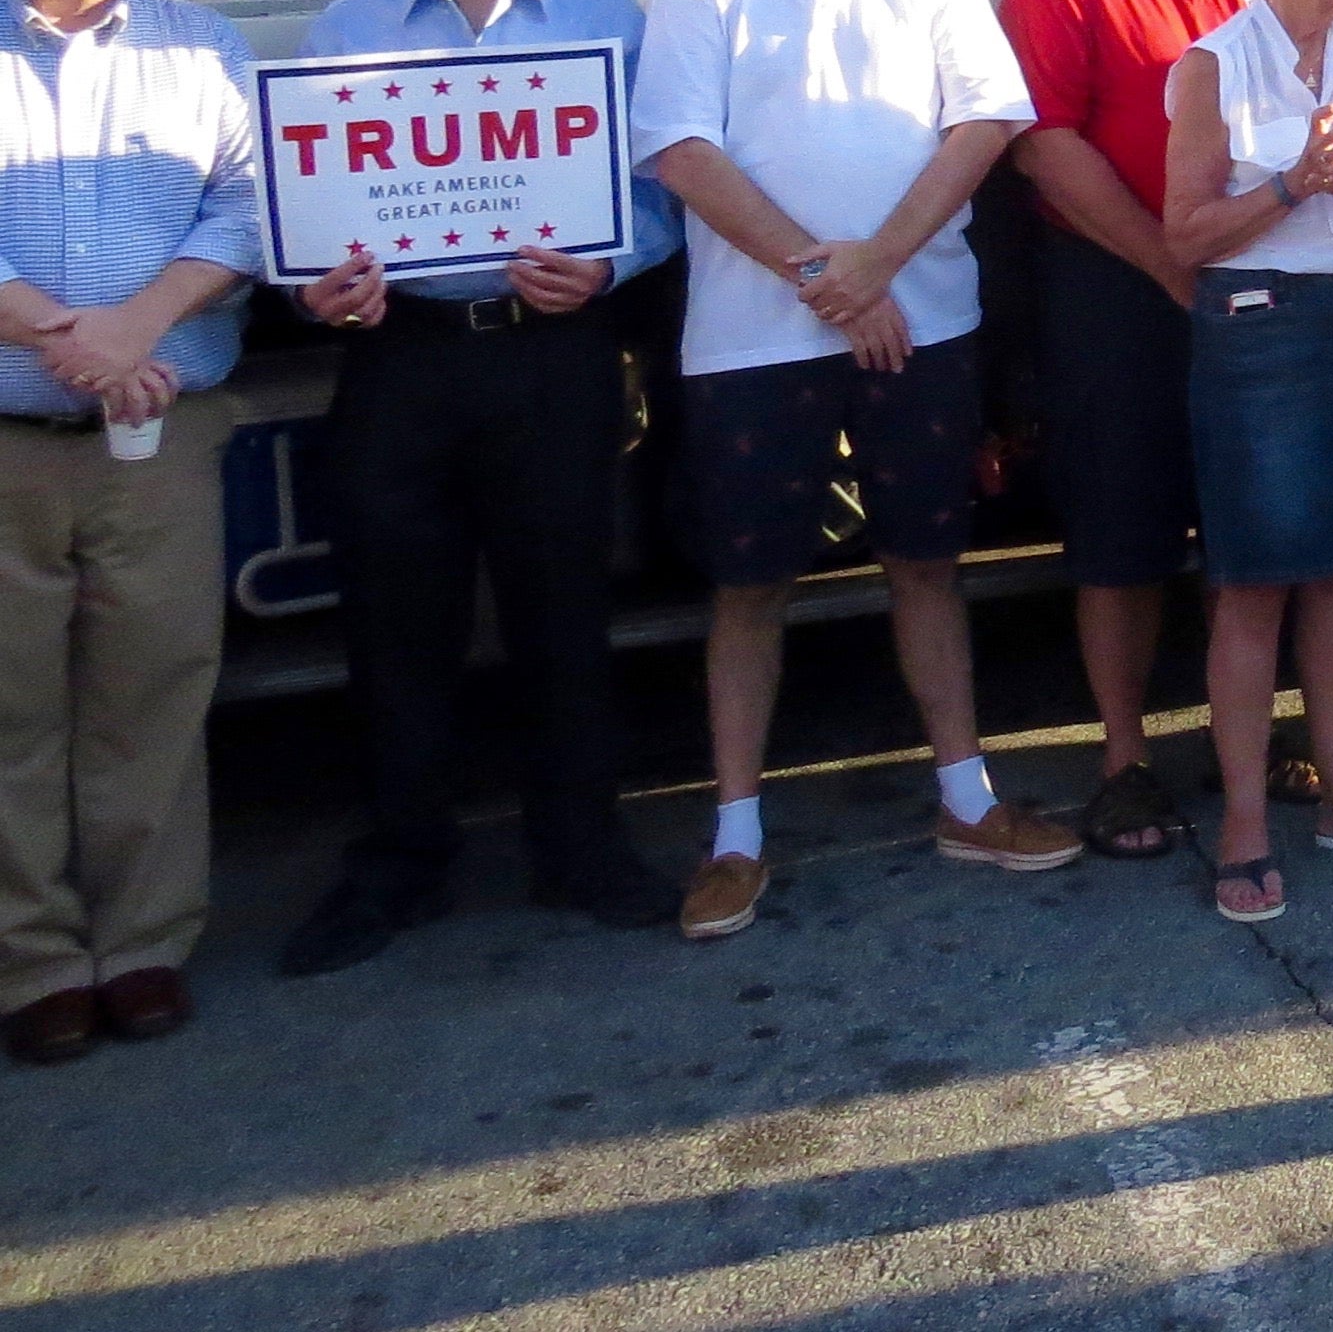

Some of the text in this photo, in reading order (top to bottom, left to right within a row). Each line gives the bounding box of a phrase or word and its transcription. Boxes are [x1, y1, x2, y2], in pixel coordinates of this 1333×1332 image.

[282, 105, 599, 176] TRUMP
[369, 174, 526, 199] MAKE AMERICA
[377, 197, 520, 222] GREAT AGAIN!
